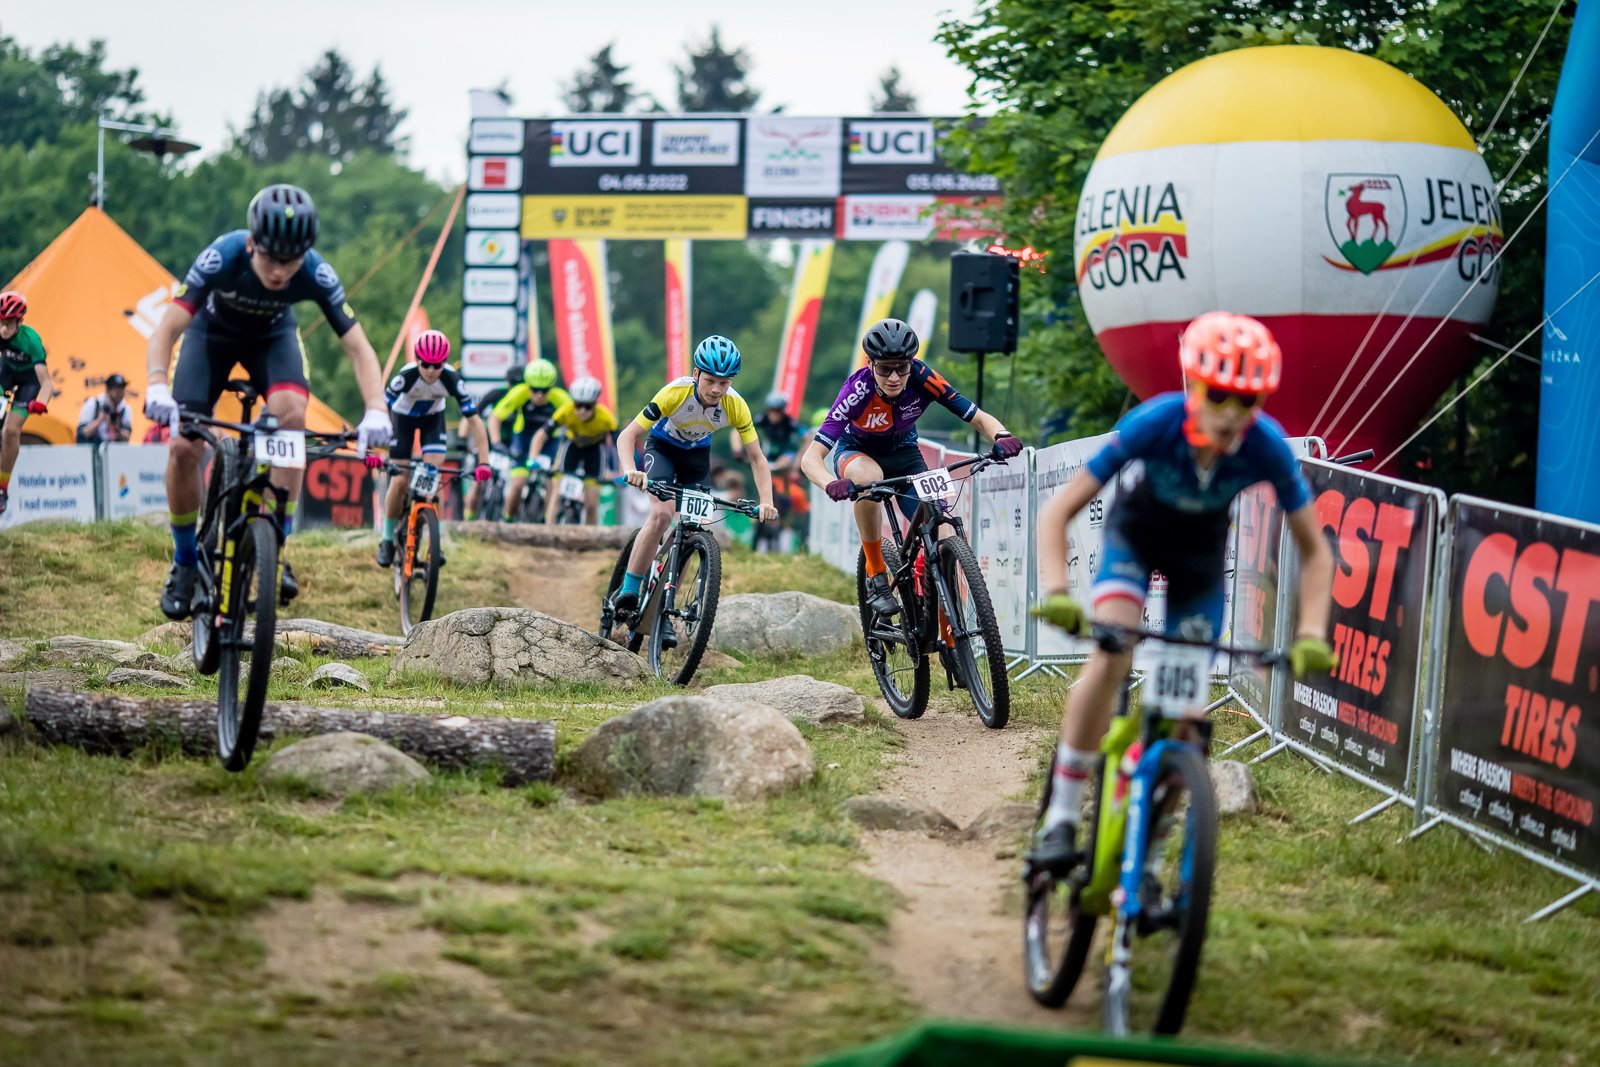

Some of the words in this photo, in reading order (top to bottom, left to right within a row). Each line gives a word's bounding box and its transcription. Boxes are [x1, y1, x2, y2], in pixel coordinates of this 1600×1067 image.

[568, 131, 630, 156] UCI
[866, 131, 924, 154] UCI
[752, 207, 832, 228] FINISH
[1079, 182, 1183, 236] ELENIA
[1087, 233, 1186, 290] GÓRA
[831, 380, 870, 422] quest
[265, 438, 295, 458] 601
[307, 457, 368, 503] CST
[920, 475, 948, 495] 603
[686, 497, 709, 517] 602
[1462, 532, 1600, 685] CST
[1331, 623, 1392, 697] TIRES
[1294, 681, 1313, 708] WHERE
[1312, 690, 1338, 719] PASSION
[1500, 684, 1582, 770] TIRES
[1450, 747, 1477, 780] WHERE
[1477, 758, 1511, 794] PASSION
